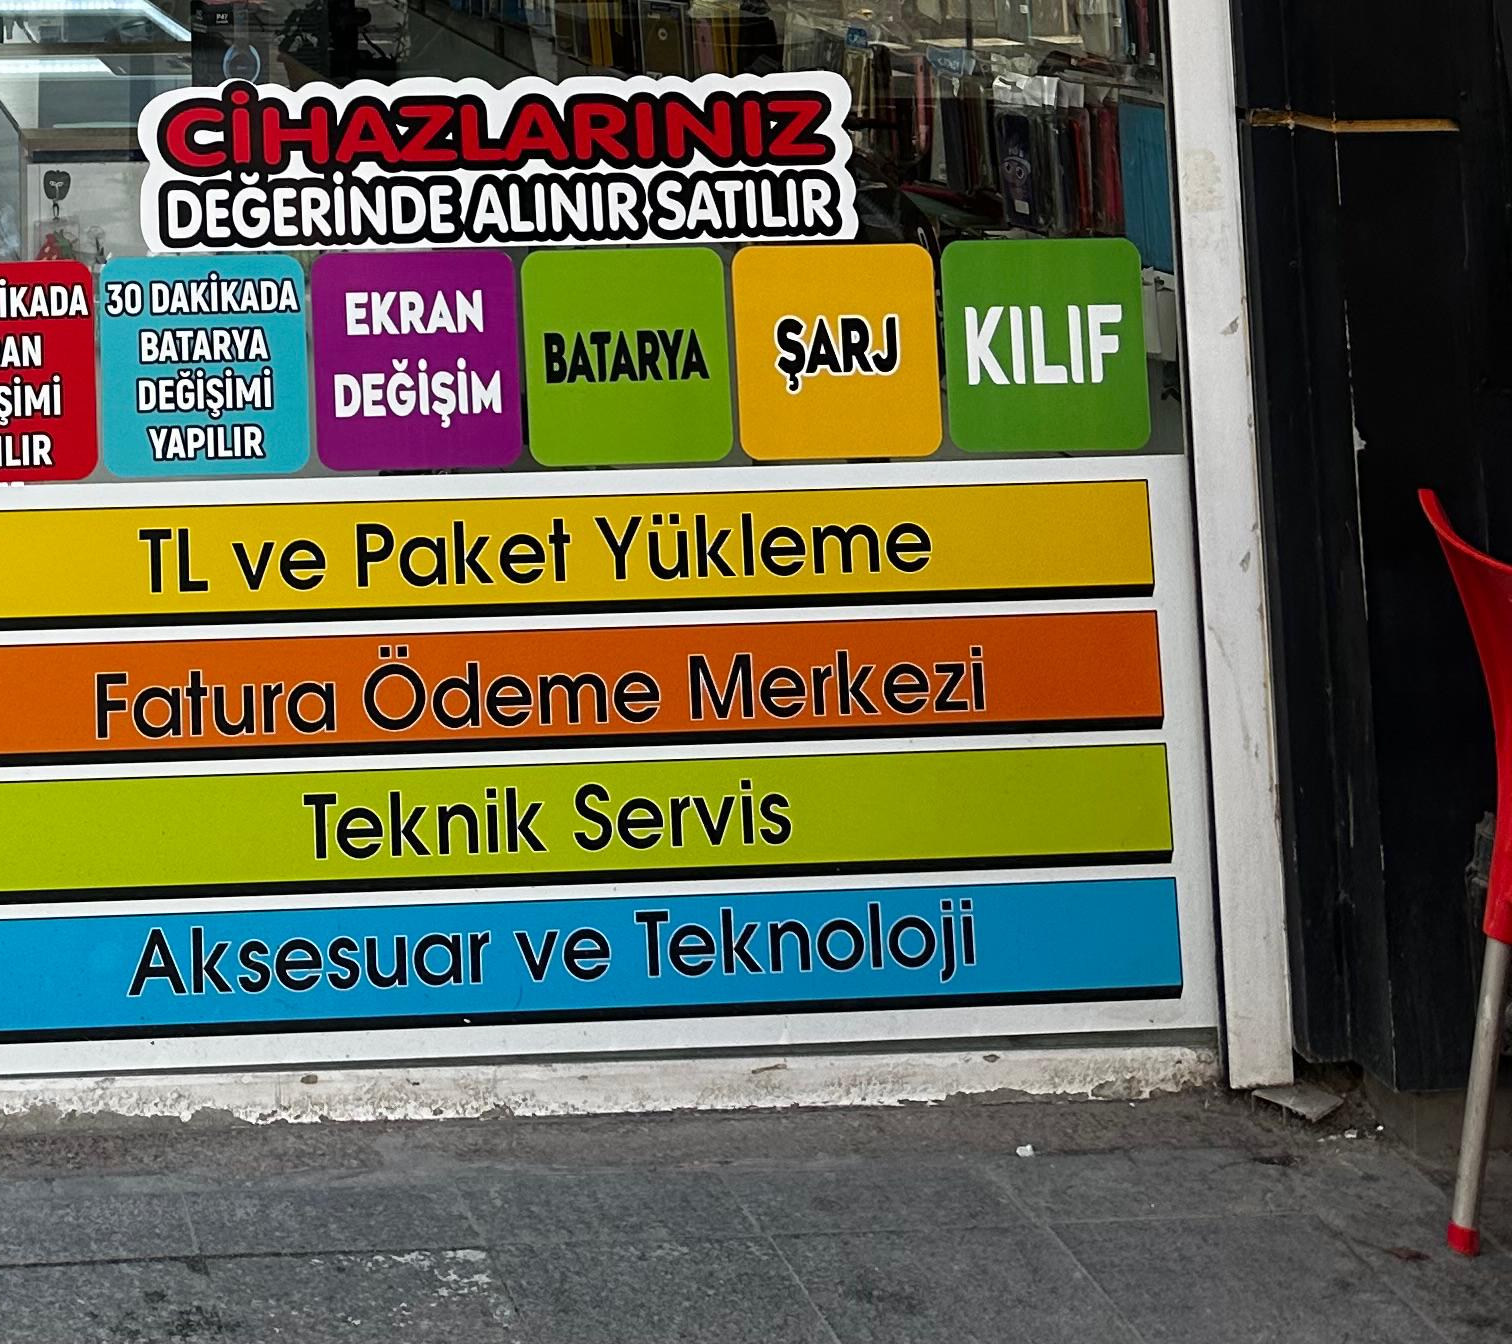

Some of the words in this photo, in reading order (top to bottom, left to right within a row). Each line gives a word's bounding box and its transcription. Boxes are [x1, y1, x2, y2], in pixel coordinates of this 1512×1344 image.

[470, 179, 646, 235] ALINIR
[653, 178, 835, 231] SATILIR
[107, 283, 141, 314] 30
[150, 274, 300, 314] DAKİKADA
[346, 289, 484, 336] EKRAN
[141, 327, 269, 362] BATARYA
[544, 328, 710, 385] BATARYA
[775, 314, 901, 394] ŞARJ
[964, 304, 1123, 386] KILIF
[138, 369, 272, 417] DEĞİŞİMİ
[335, 357, 503, 429] DEĞİŞİM
[149, 426, 263, 460] YAPILIR
[139, 528, 209, 594] TL
[231, 538, 327, 591] ve
[355, 517, 571, 589] Paket
[594, 512, 932, 581] Yükleme
[94, 669, 337, 740] Fatura
[363, 645, 660, 731] Ödeme
[688, 645, 986, 722] Merkezi
[303, 787, 549, 861] Teknik
[573, 779, 793, 852] Servis
[128, 925, 491, 997] Aksesuar
[515, 925, 611, 982] ve
[634, 897, 977, 984] Teknoloji
